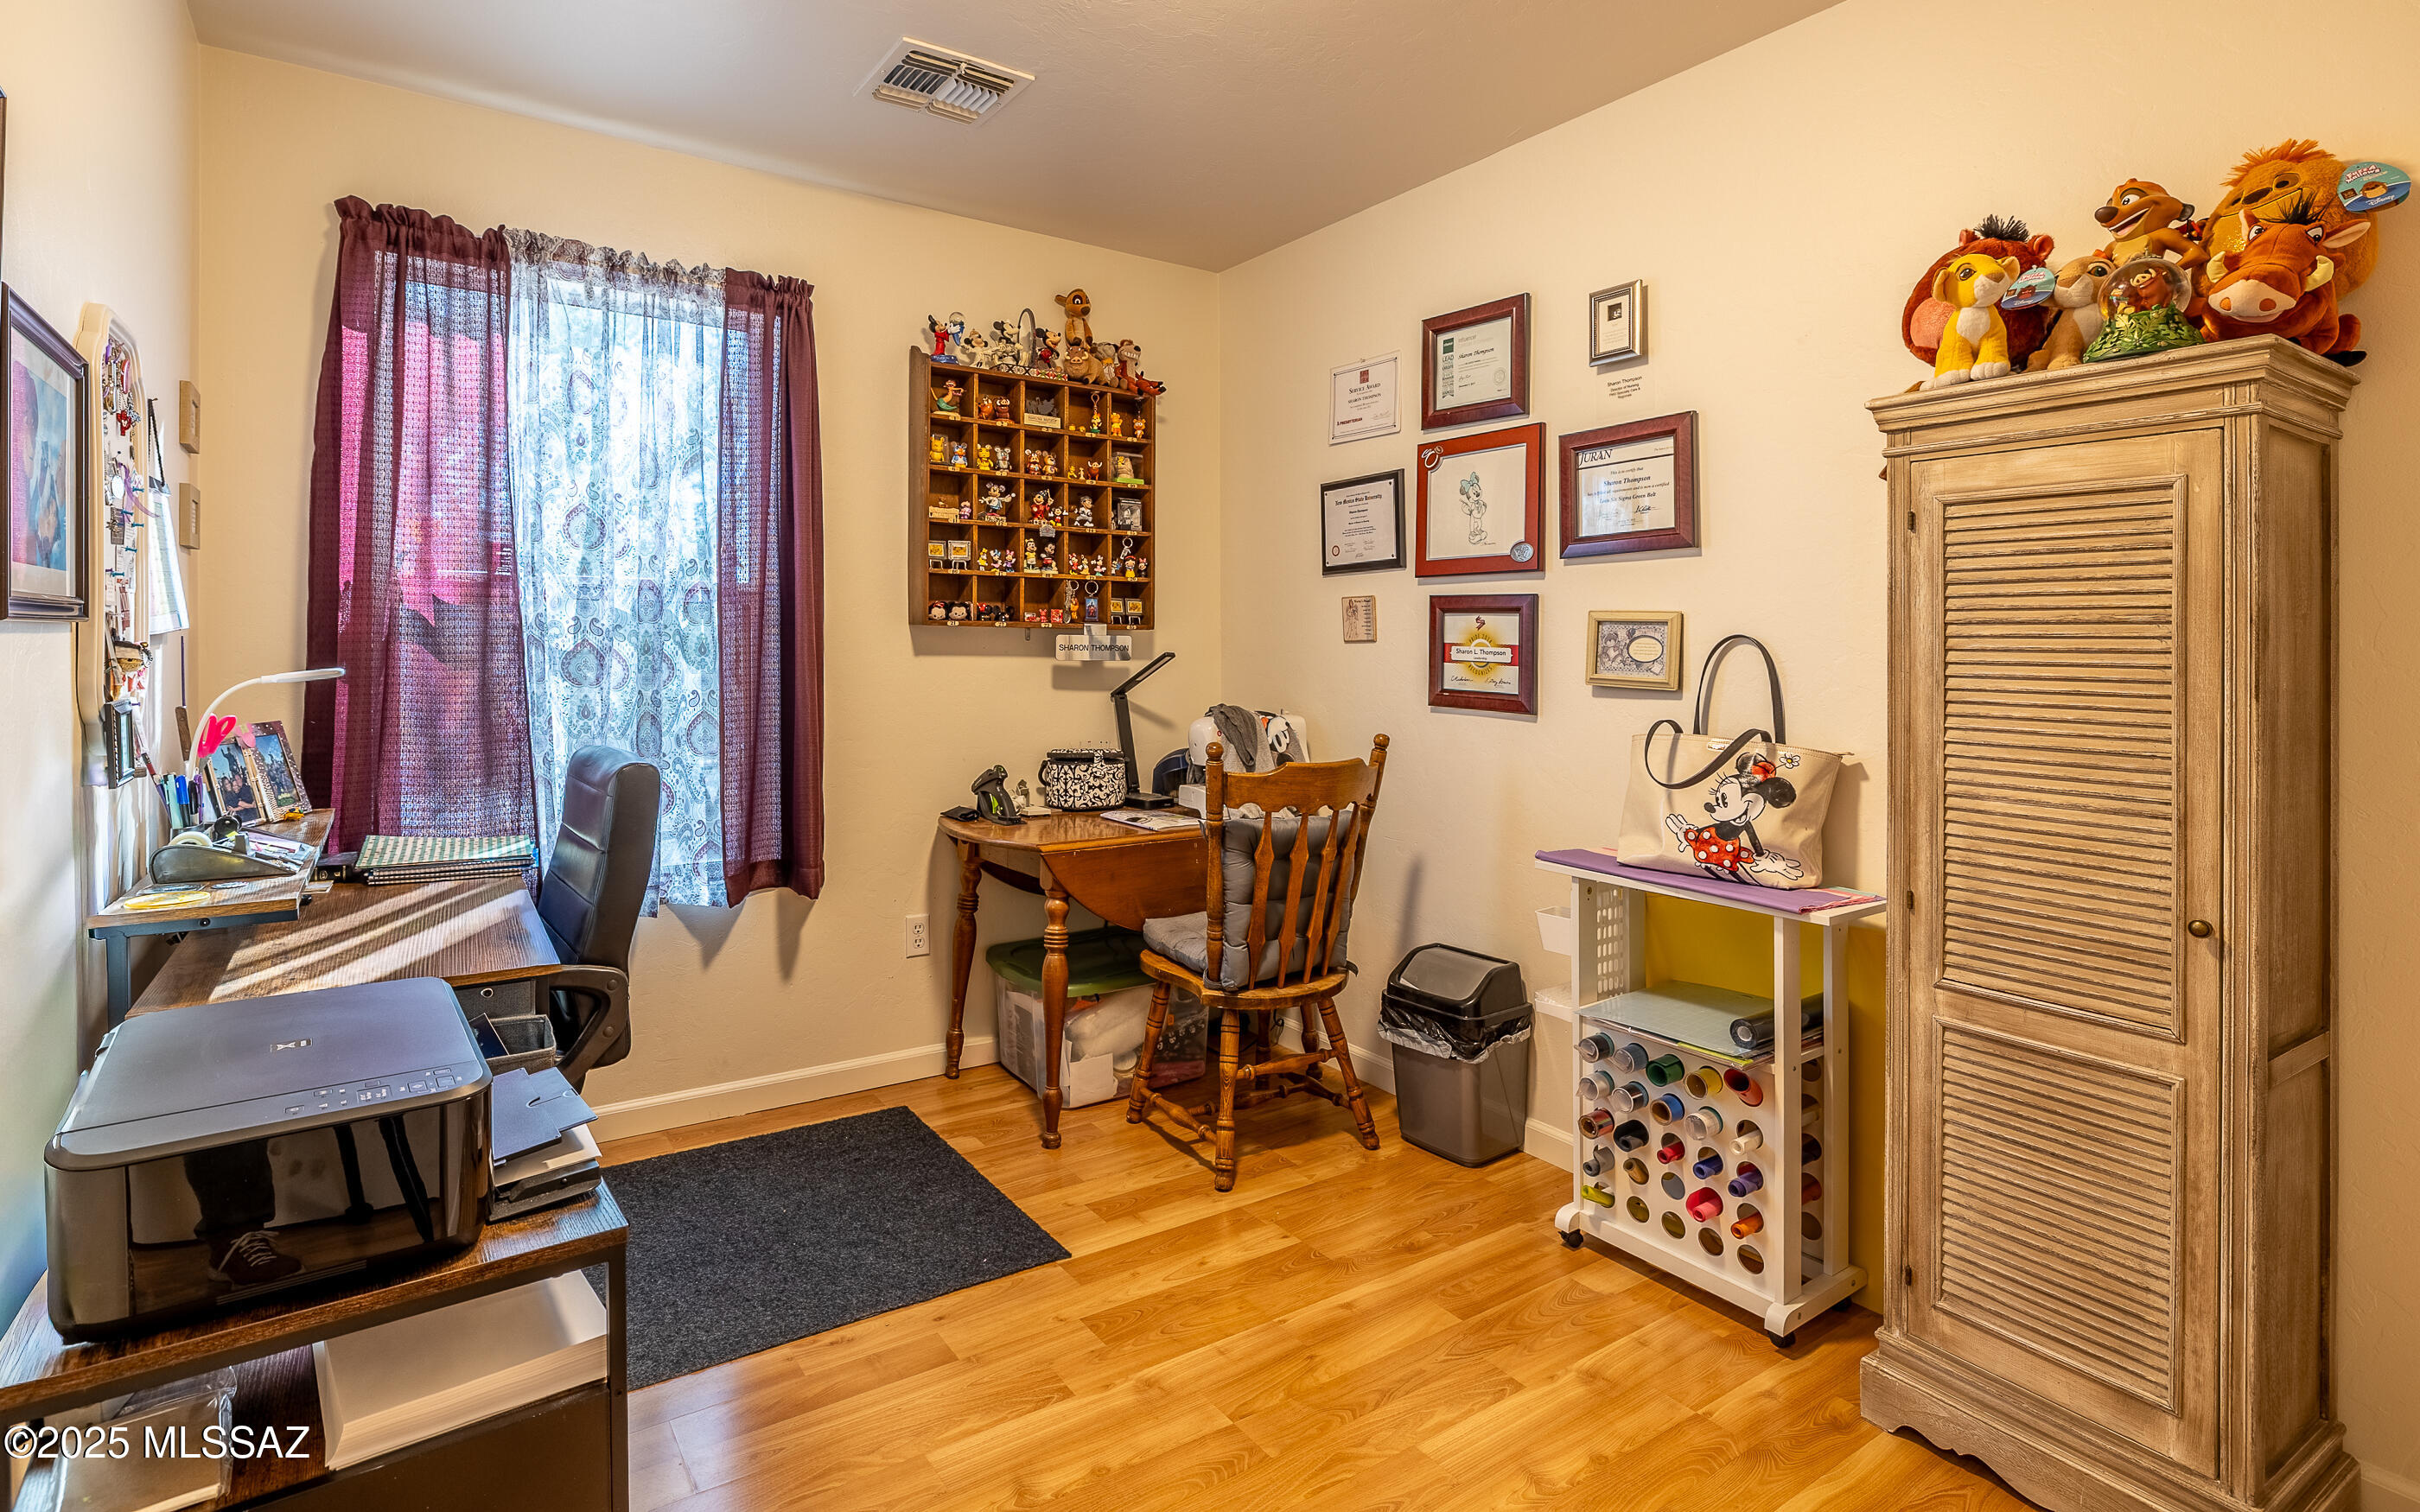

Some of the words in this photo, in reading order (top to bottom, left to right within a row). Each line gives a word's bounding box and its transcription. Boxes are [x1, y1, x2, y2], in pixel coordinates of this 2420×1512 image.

[2366, 195, 2395, 206] Disney
[1578, 448, 1613, 467] JURAN
[1623, 475, 1652, 485] Thompson
